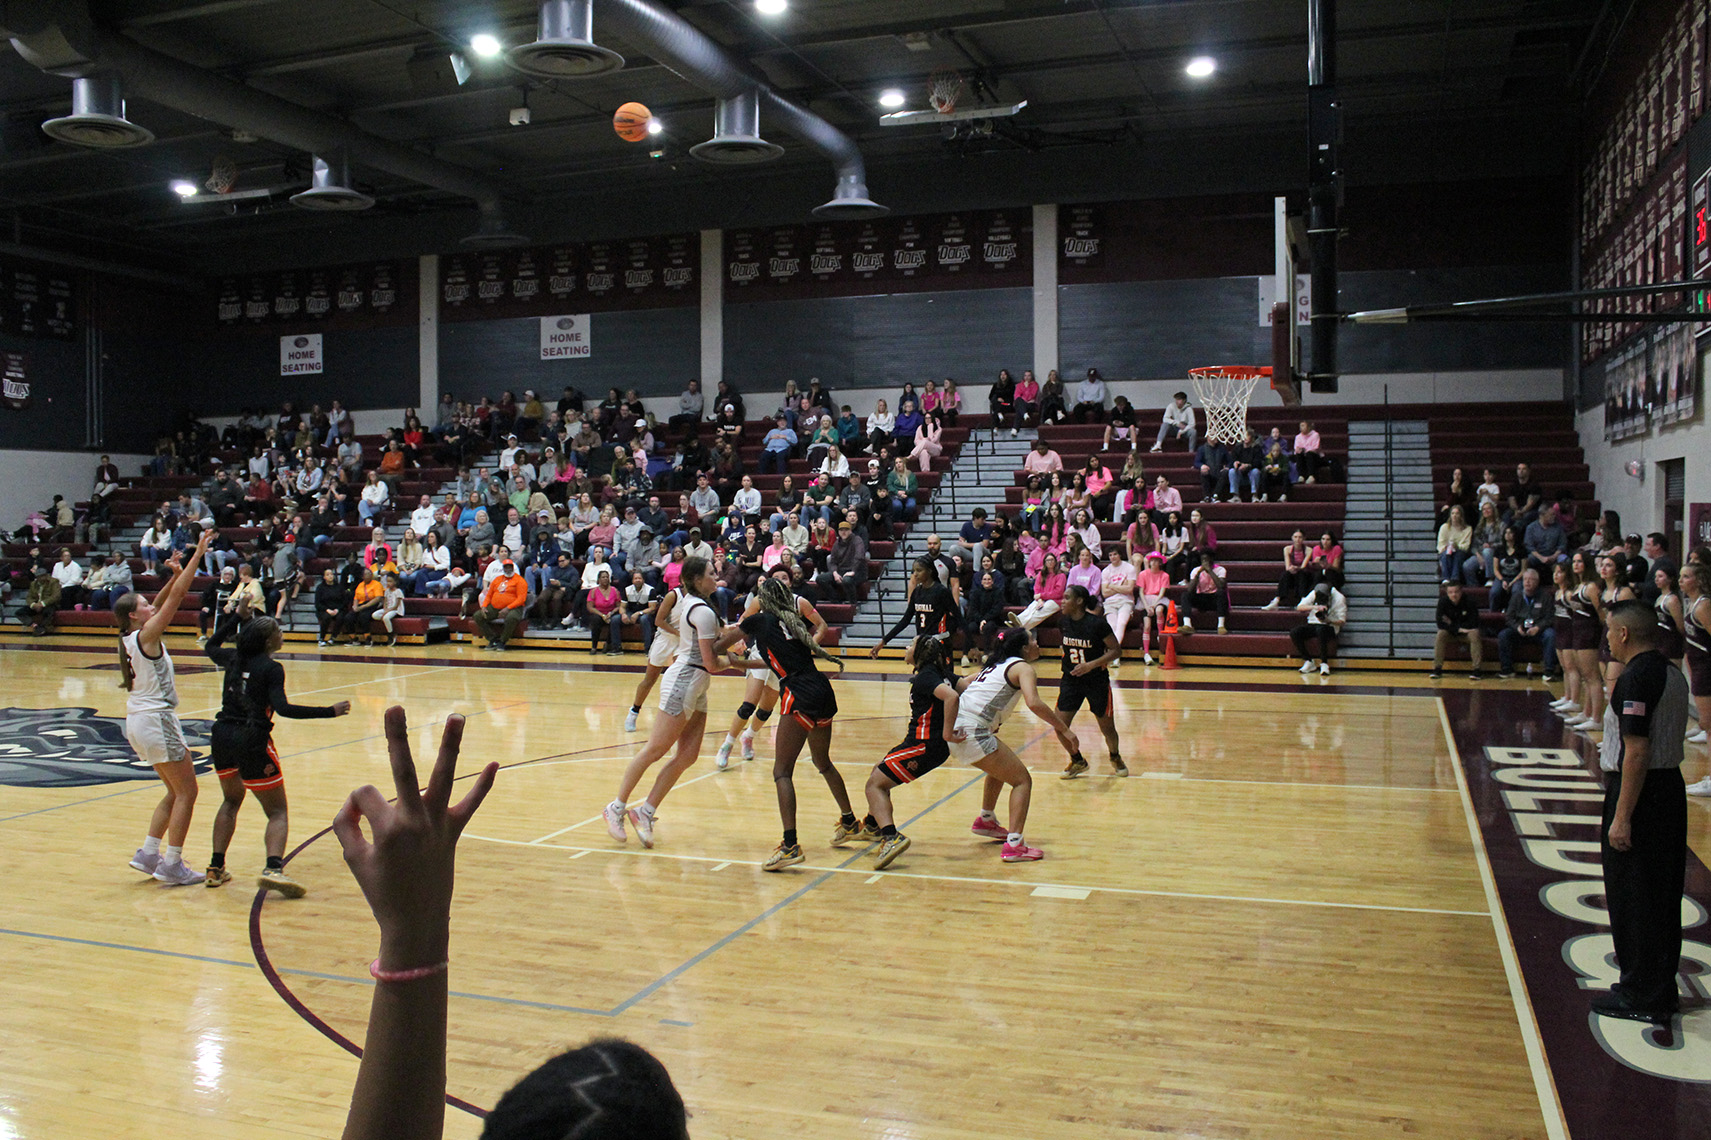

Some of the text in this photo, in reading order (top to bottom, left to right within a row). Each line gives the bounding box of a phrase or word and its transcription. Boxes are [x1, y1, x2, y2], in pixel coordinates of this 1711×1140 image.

[549, 332, 581, 343] HOME
[288, 350, 315, 360] HOME
[542, 345, 590, 357] SEATING
[282, 362, 322, 373] SEATING
[1069, 648, 1087, 664] 21
